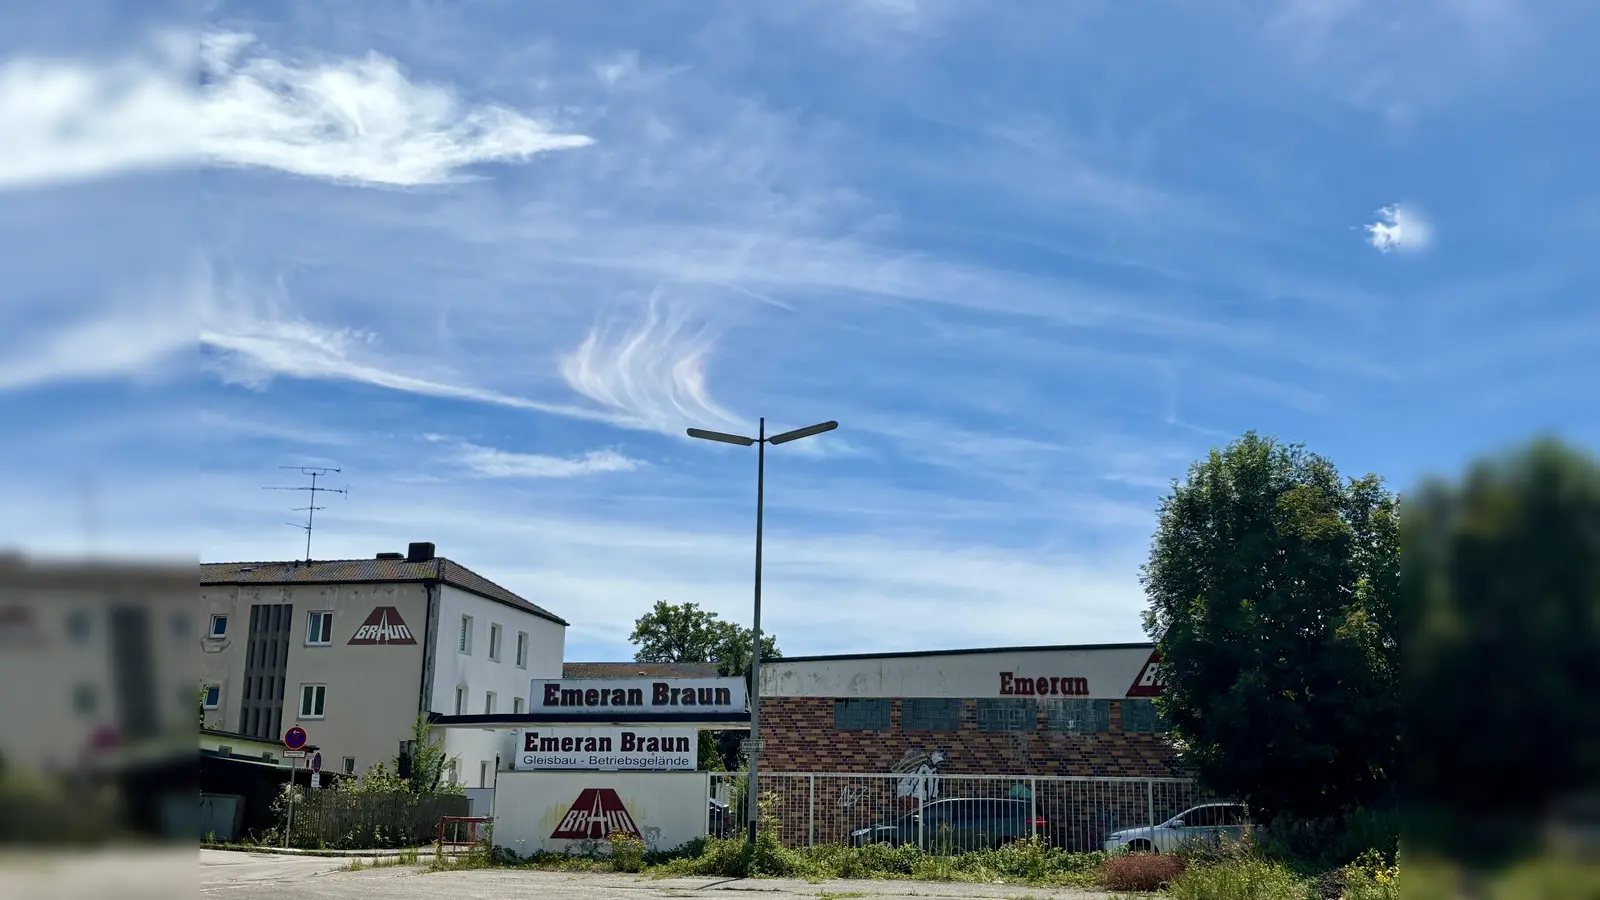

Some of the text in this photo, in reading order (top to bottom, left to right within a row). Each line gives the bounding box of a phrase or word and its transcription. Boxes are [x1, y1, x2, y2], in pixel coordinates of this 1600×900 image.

[354, 609, 411, 643] BRAUN
[543, 682, 731, 706] Emeran Braun
[999, 671, 1089, 695] Emeran
[524, 732, 690, 752] Emeran Braun
[523, 755, 576, 765] Gleisbau
[589, 755, 689, 767] Betriebsgelände
[558, 789, 636, 839] BRAUN
